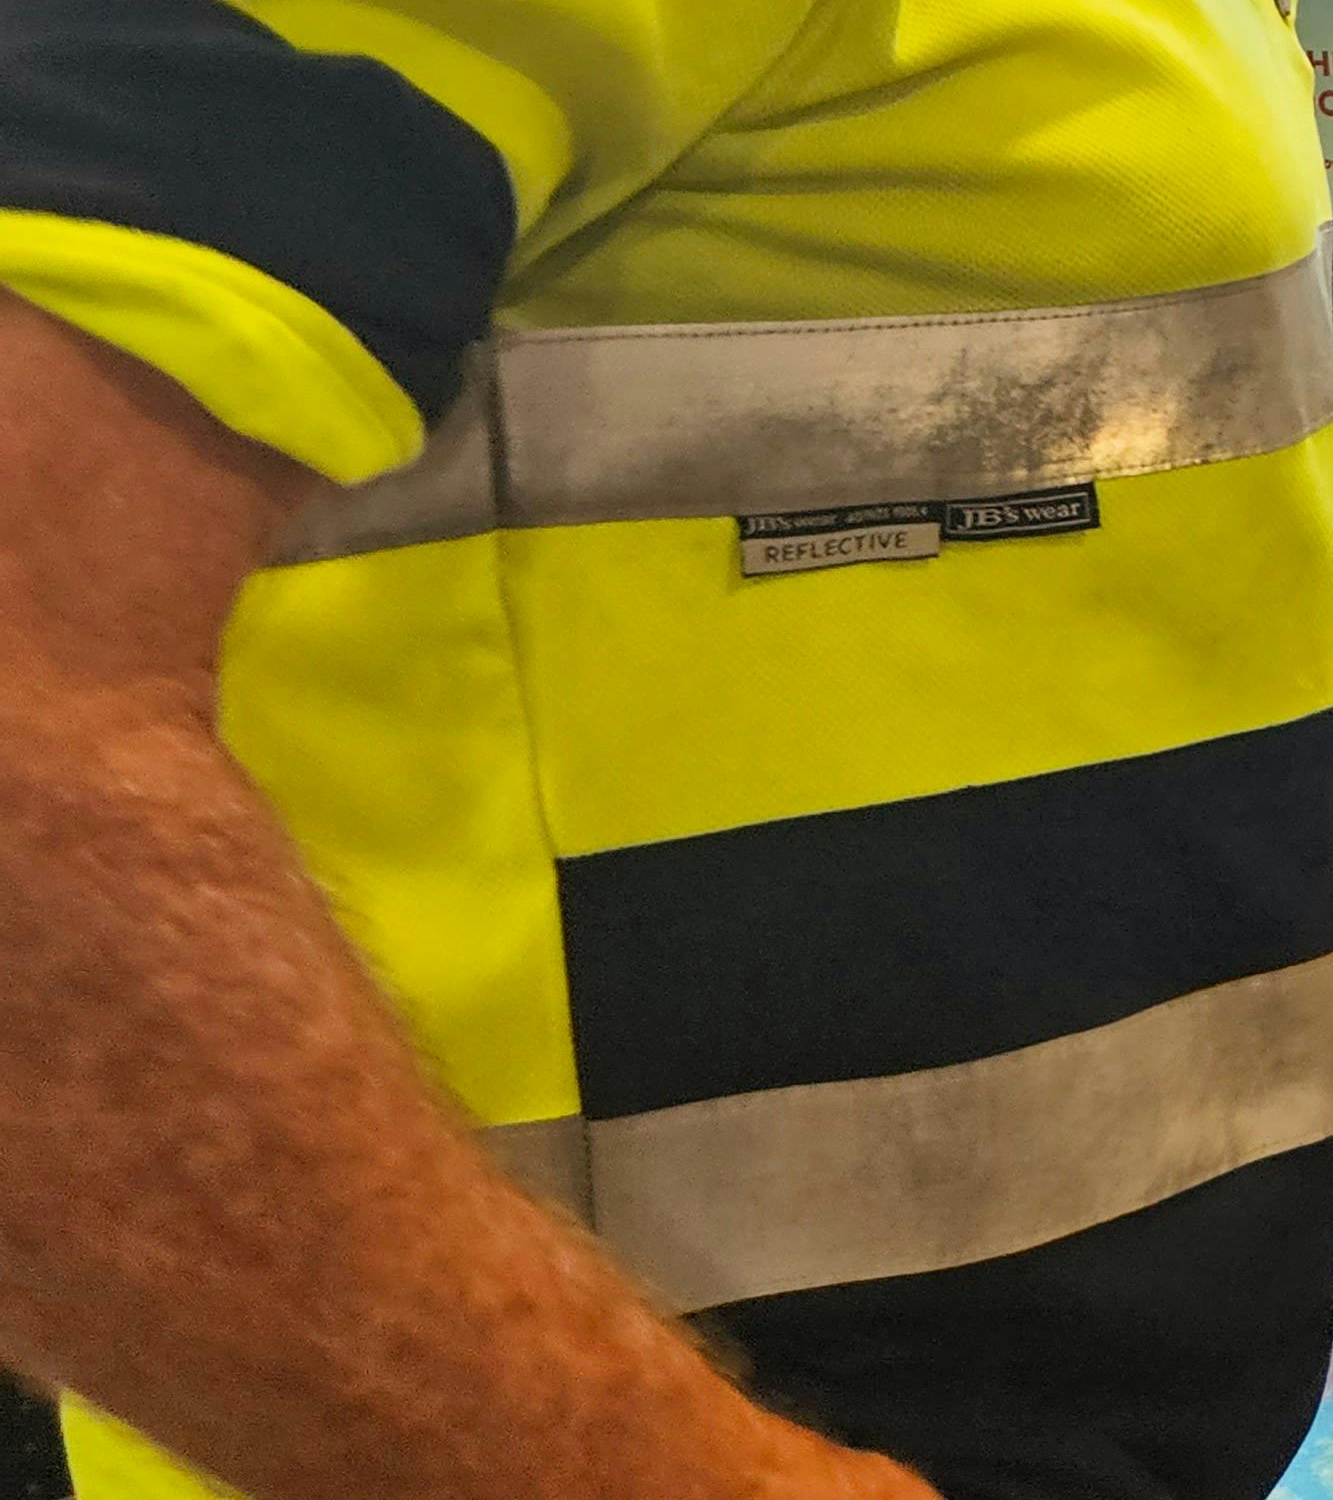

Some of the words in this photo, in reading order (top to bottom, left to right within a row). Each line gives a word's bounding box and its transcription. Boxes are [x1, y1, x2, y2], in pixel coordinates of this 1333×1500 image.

[957, 505, 1018, 530] JB's
[1024, 500, 1081, 521] wear
[764, 530, 909, 564] REFLECTIVE
